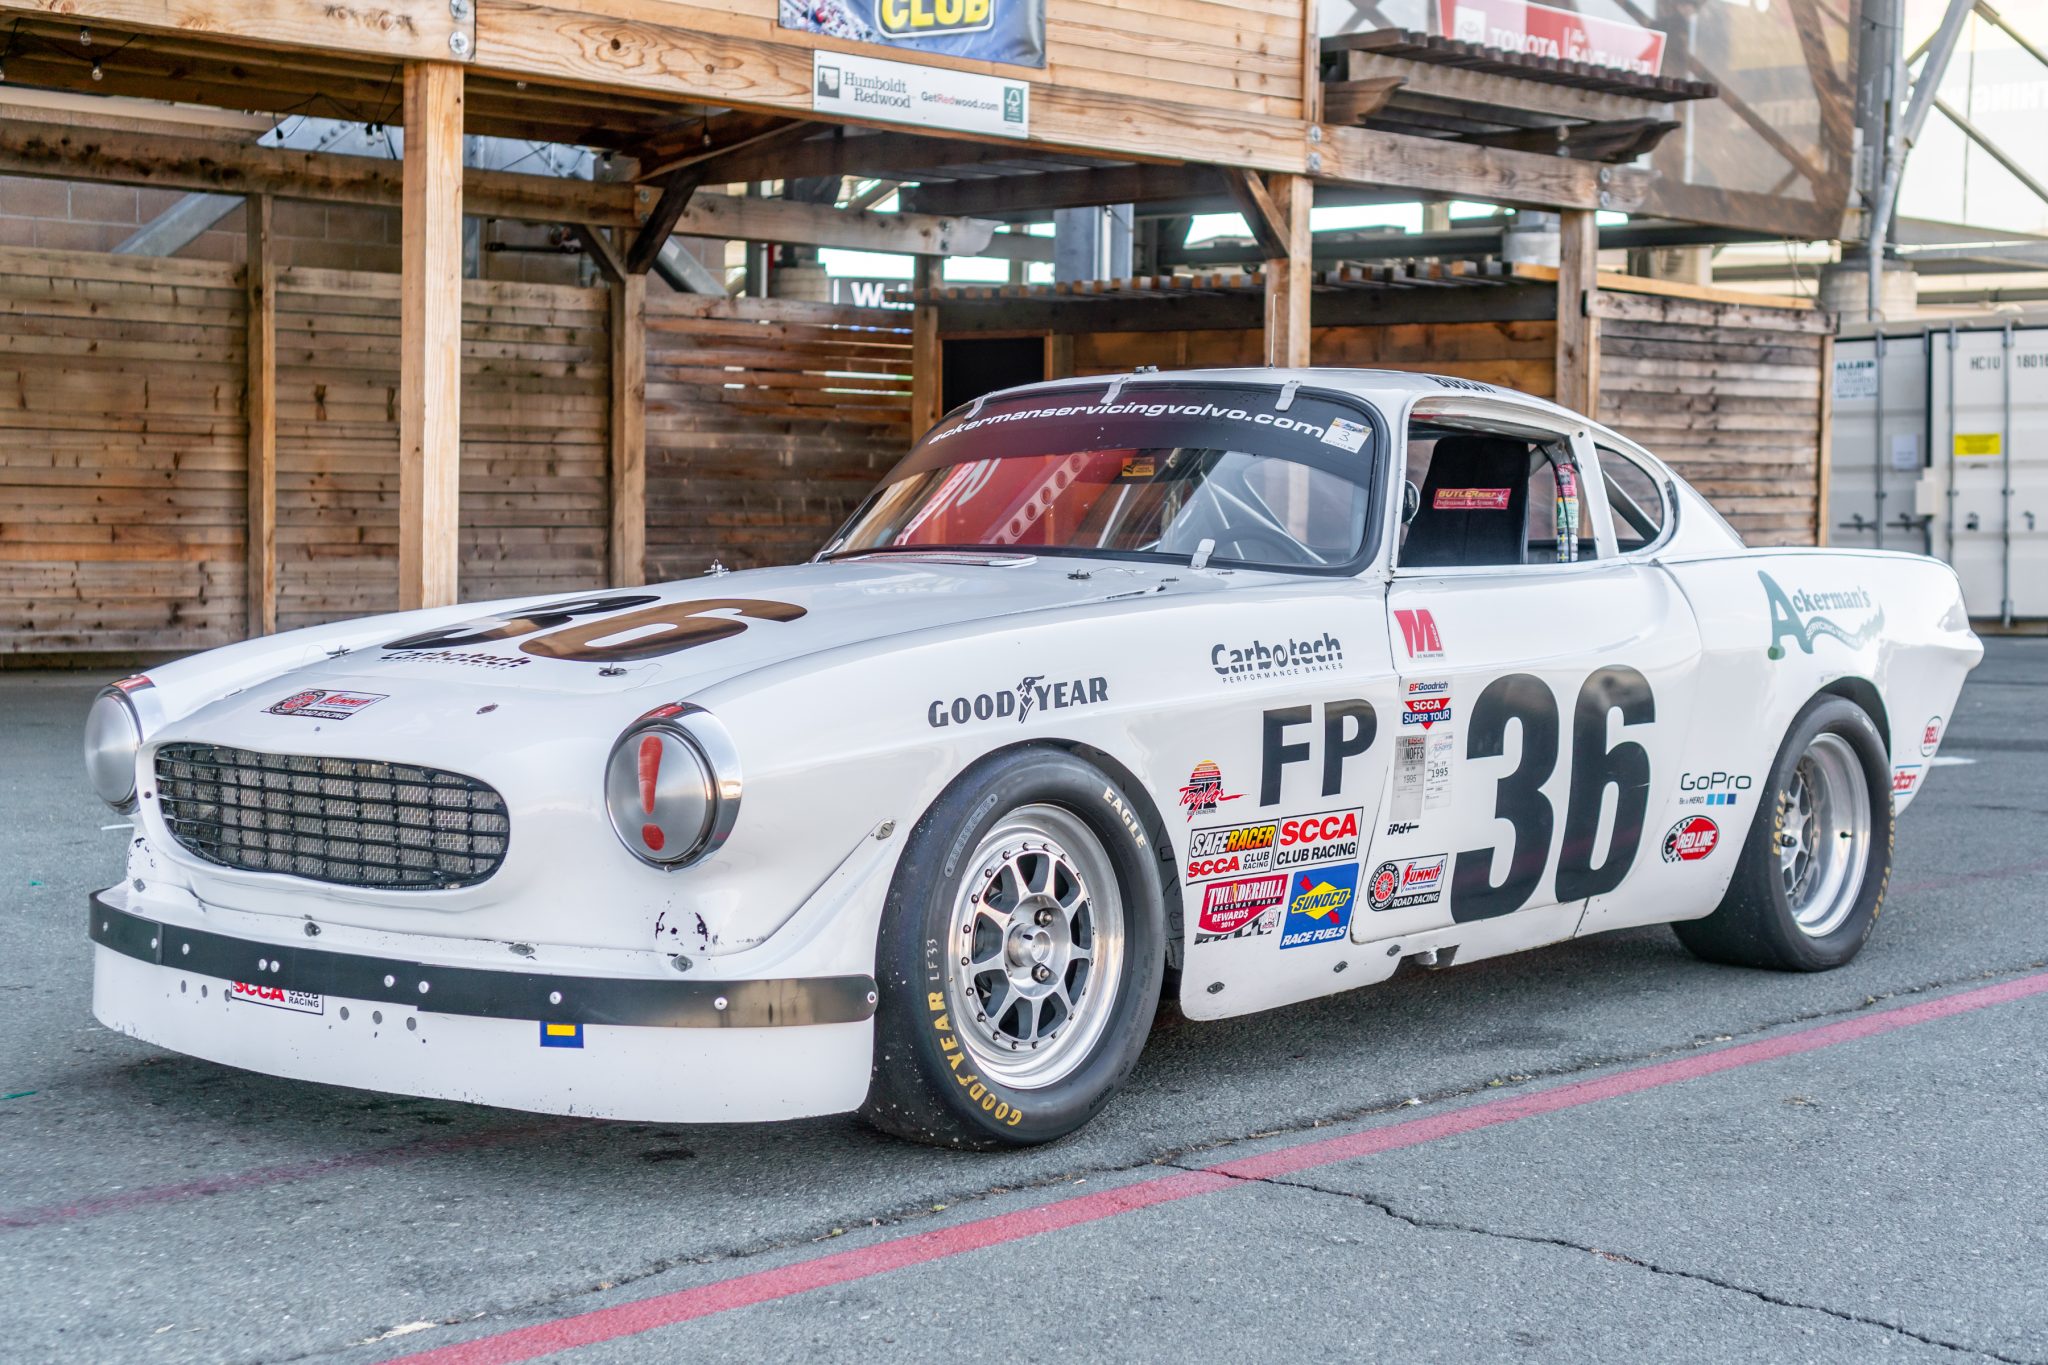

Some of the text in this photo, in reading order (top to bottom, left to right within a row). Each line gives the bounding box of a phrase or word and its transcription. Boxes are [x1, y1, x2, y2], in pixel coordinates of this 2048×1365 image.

[881, 0, 989, 28] CLUB
[1490, 28, 1559, 59] TOYOTA
[844, 71, 907, 94] Humboldt
[854, 87, 912, 109] Redwood
[921, 90, 999, 112] GetRedwood.com
[928, 402, 1325, 445] ackermanservicingvolvo.com
[1758, 570, 1872, 660] Ackerman's
[382, 594, 808, 662] 36
[1211, 632, 1343, 675] Carbotech
[1222, 662, 1343, 683] PERFORMANCE BRAKES
[1409, 681, 1448, 692] BFGoodrich
[1404, 709, 1450, 723] SUPER TOUR
[1413, 699, 1441, 711] SCCA
[1260, 697, 1378, 807] FP
[1431, 766, 1449, 779] 1995
[1680, 771, 1752, 791] GoPro
[1178, 781, 1250, 823] Taylor
[1450, 663, 1656, 924] 36
[1102, 785, 1146, 849] EAGLE
[1772, 789, 1788, 857] EAGLE
[1280, 813, 1358, 846] SCCA
[1678, 830, 1717, 849] RED LINE
[1190, 825, 1277, 858] SAFERACER
[1244, 851, 1270, 863] CLUB
[1276, 841, 1356, 866] CLUB RACING
[1187, 855, 1240, 878] SCCA
[1242, 860, 1269, 871] RACING
[1206, 879, 1284, 915] THUNDERHILL
[1213, 897, 1277, 912] RACEWAY PARK
[1293, 889, 1349, 913] SUNOCO
[1391, 892, 1440, 908] ROAD RACING
[1281, 925, 1347, 947] RACE FUELS
[233, 981, 285, 1002] SCCA
[288, 997, 319, 1008] RACING
